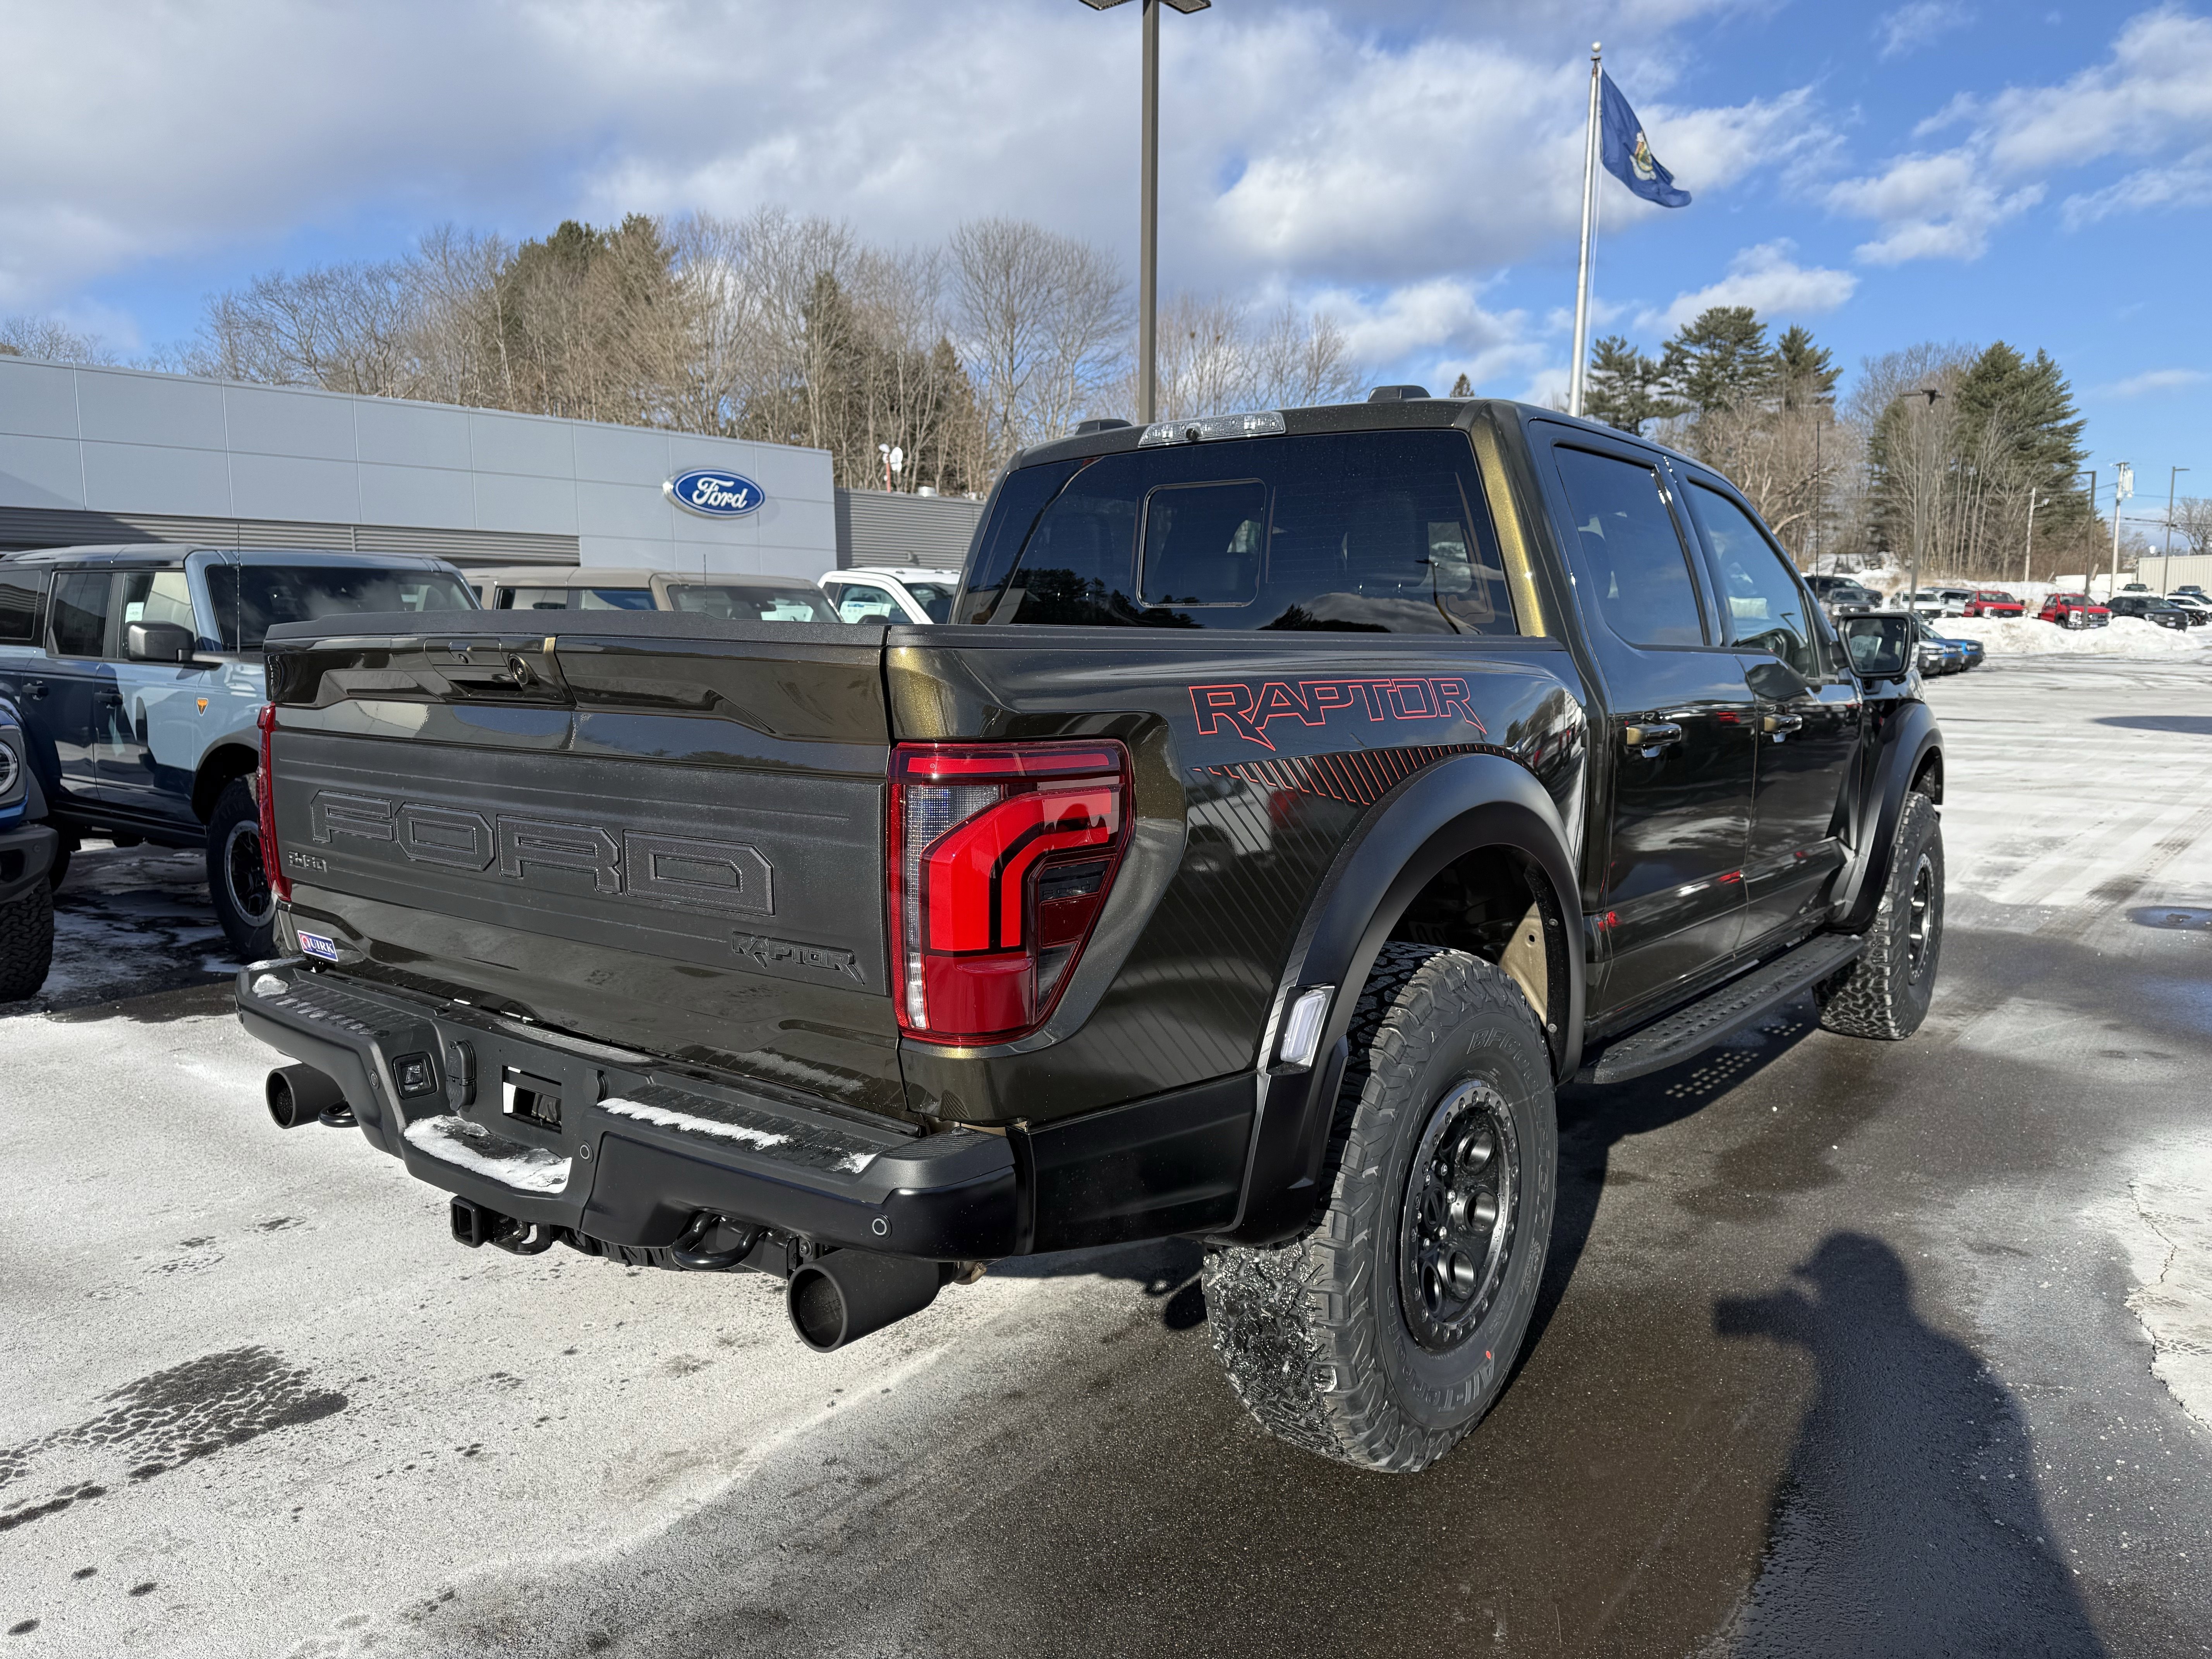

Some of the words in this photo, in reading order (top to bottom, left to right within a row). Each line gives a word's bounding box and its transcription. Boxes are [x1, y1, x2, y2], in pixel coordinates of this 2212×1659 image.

[692, 477, 748, 508] Ford
[1188, 678, 1487, 751] RAPTOR
[311, 790, 775, 916] FORD
[301, 935, 334, 954] QUIRK
[732, 931, 866, 986] RAPTOR
